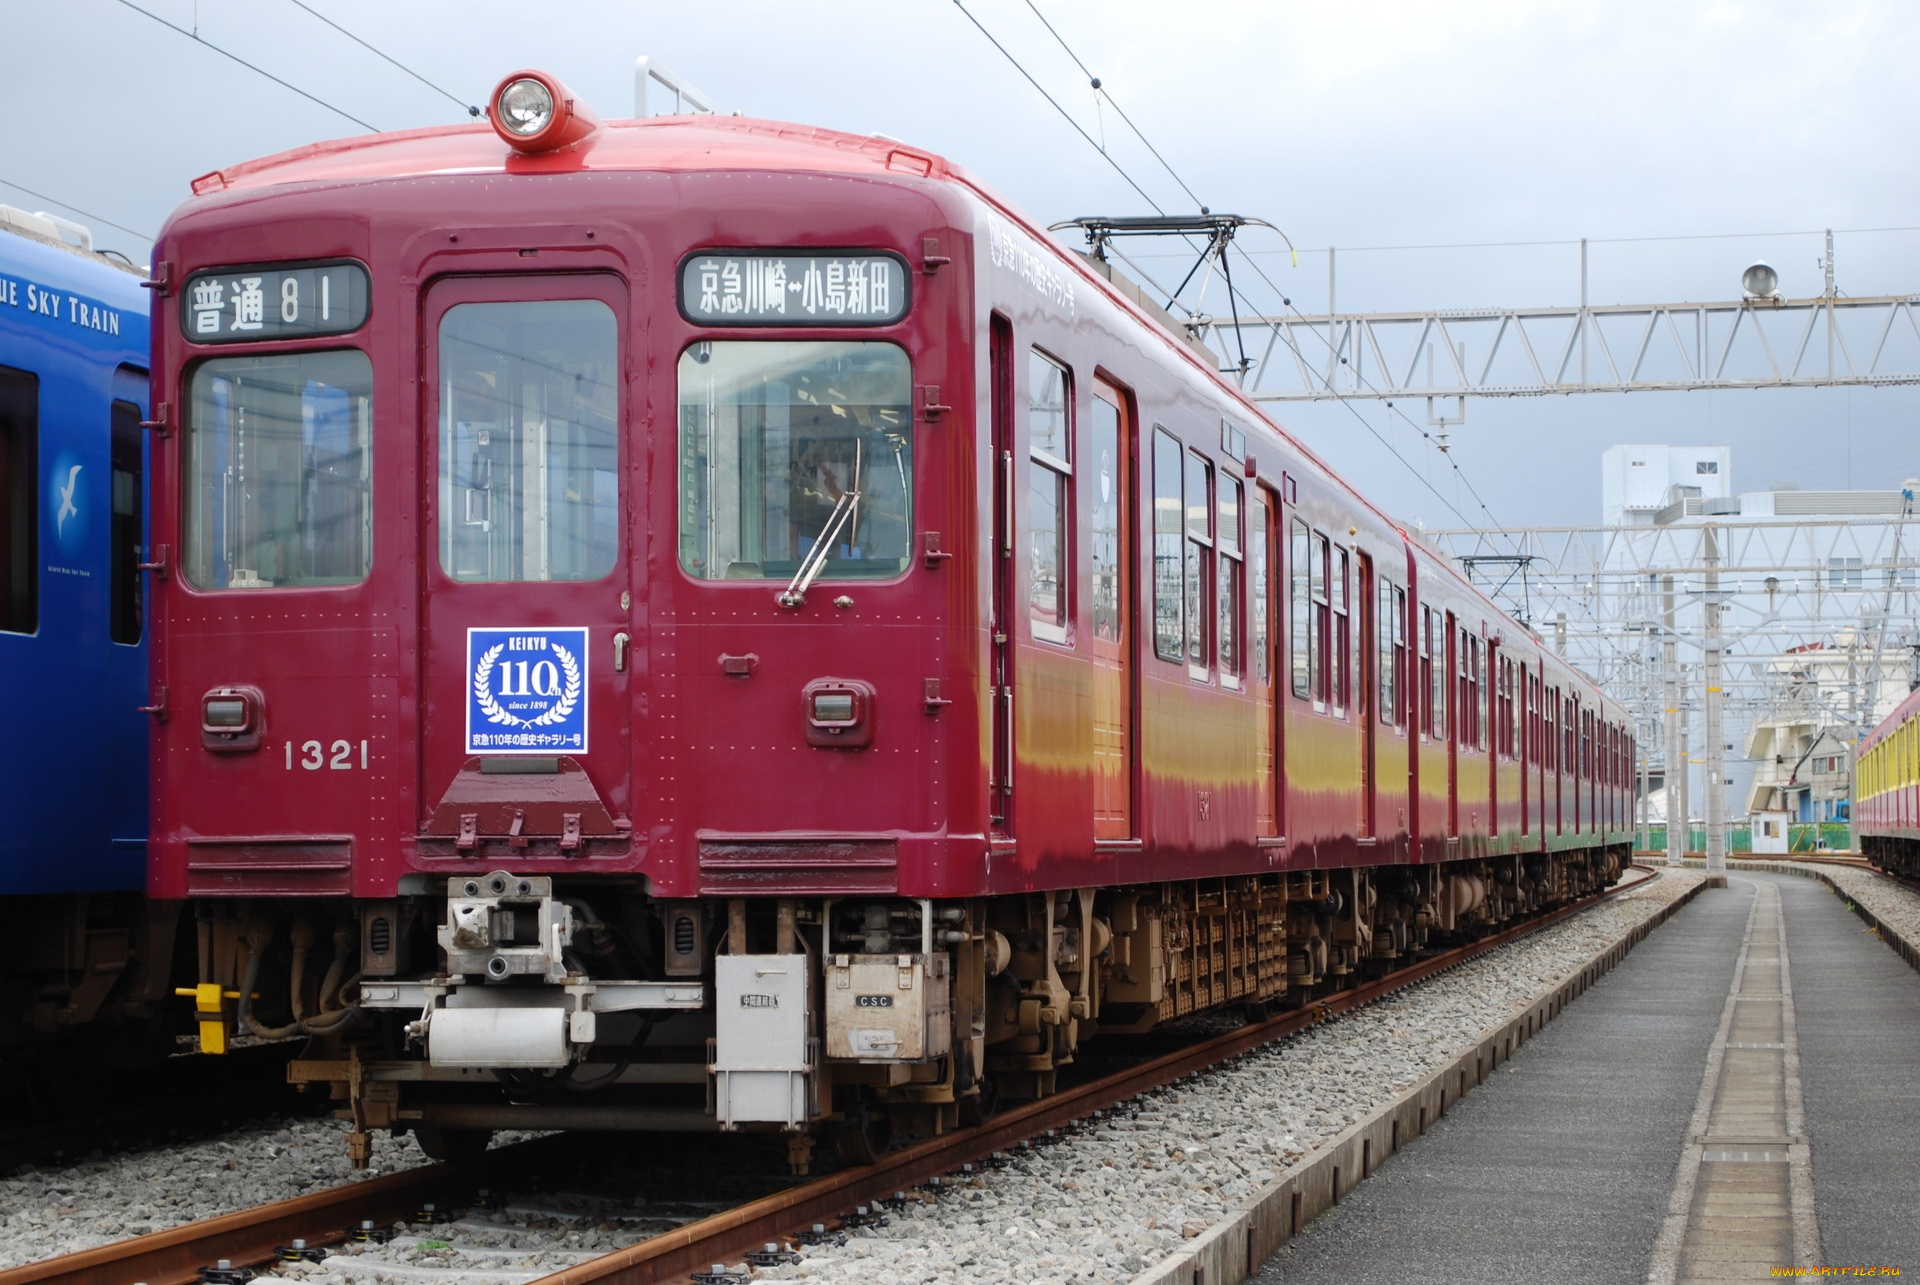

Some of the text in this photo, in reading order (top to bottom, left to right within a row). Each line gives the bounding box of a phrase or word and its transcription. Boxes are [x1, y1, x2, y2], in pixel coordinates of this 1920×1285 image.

[699, 260, 890, 314] 京急川崎 小島新田
[27, 284, 60, 318] SKY
[69, 296, 119, 336] TRAIN
[193, 277, 263, 333] 普通
[509, 637, 547, 650] KEIKYU
[508, 701, 548, 710] since 1898
[472, 733, 581, 746] 京急110年の歴史ギャラリー号
[285, 740, 368, 770] 1321
[860, 996, 888, 1007] CSC
